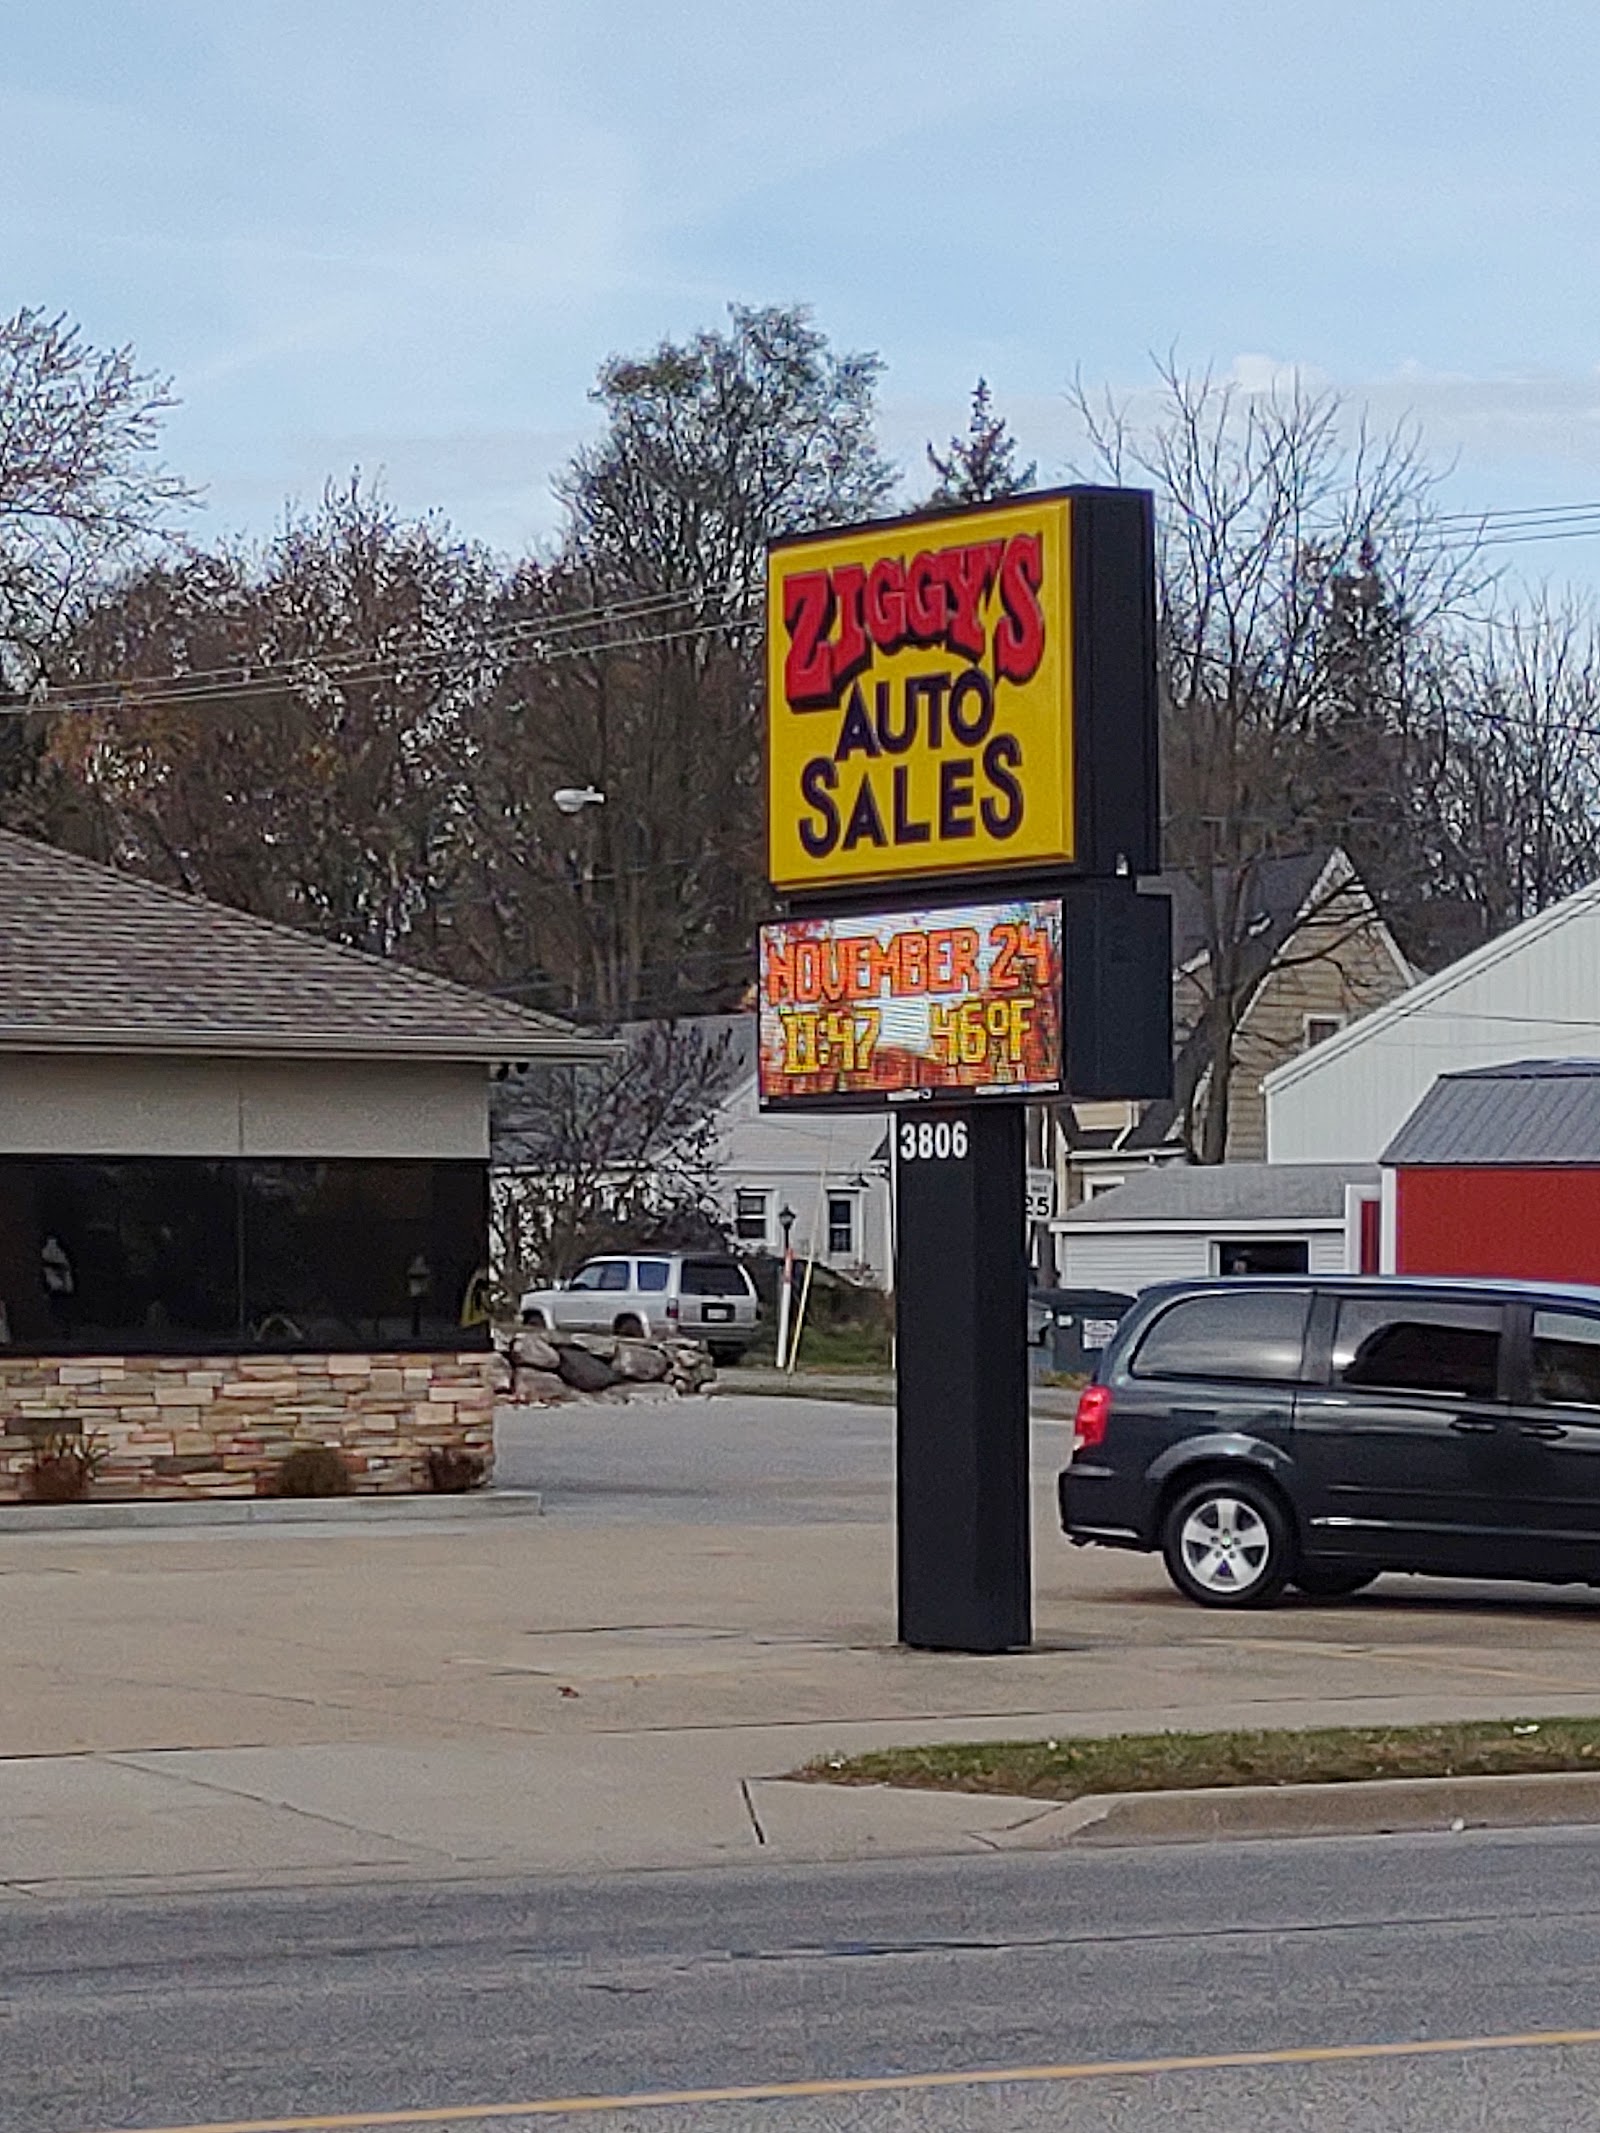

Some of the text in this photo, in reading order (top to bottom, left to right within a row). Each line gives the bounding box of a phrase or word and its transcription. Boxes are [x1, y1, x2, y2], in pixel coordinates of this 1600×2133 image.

[783, 533, 1046, 714] ZIGGY'S
[835, 669, 994, 762] AUTO
[799, 734, 1023, 858] SALES
[767, 921, 1050, 1006] NOVEMBER 24
[900, 1121, 969, 1159] 3806
